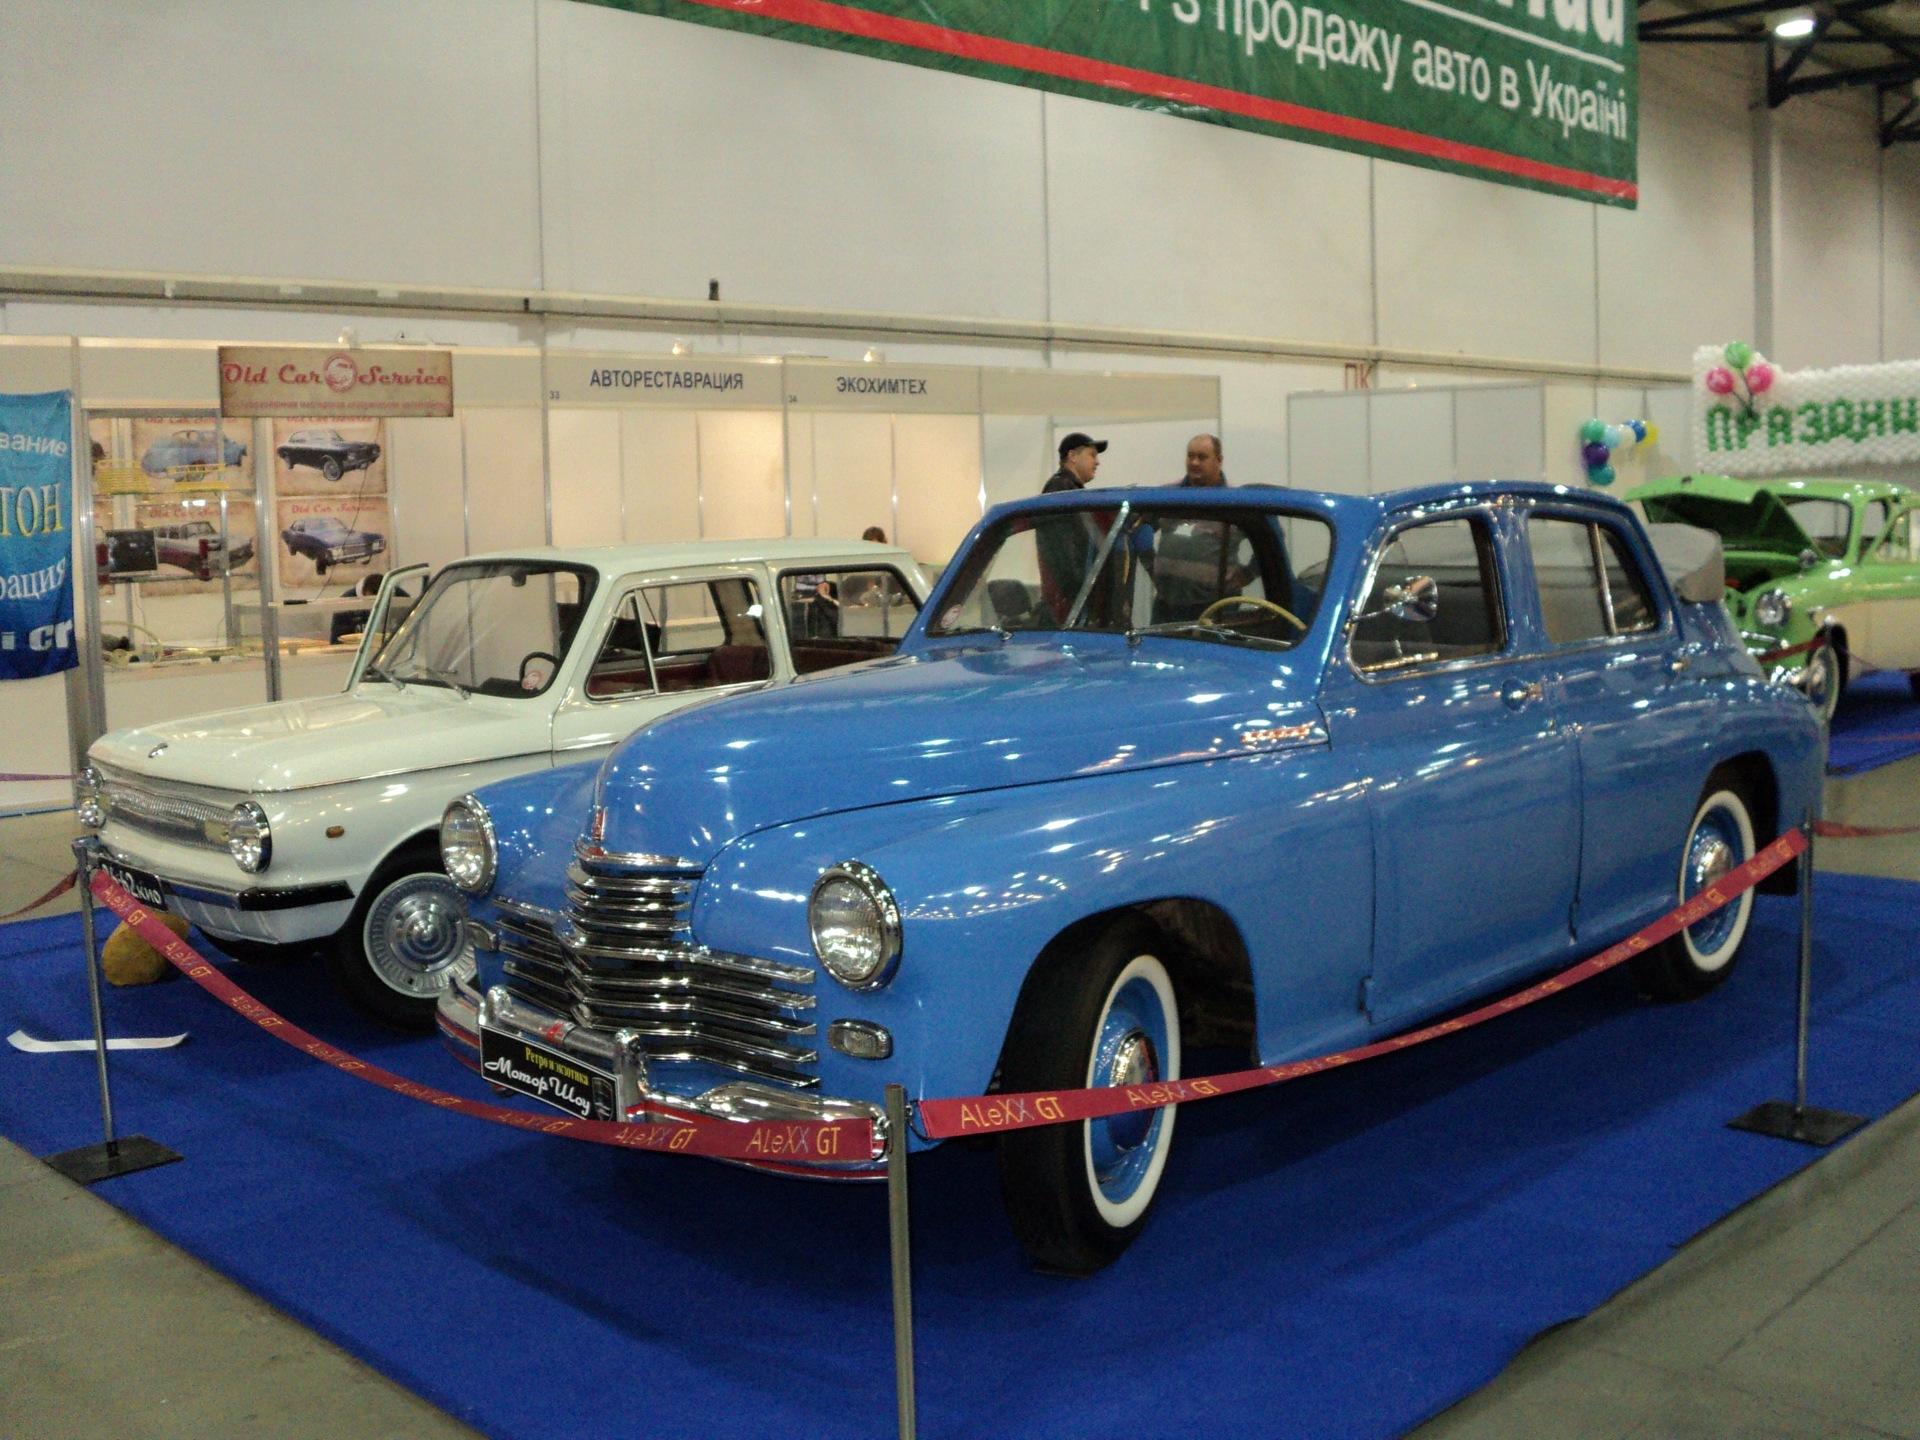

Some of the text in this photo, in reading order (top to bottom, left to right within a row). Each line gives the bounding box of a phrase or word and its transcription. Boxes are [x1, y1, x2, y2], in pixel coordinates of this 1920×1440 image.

[1412, 39, 1491, 102] авто
[1500, 65, 1520, 110] в
[1526, 58, 1627, 140] Україні
[222, 362, 268, 385] Old
[278, 363, 323, 386] Car
[357, 364, 450, 387] Service
[589, 368, 744, 393] АВТОРЕСТАВРАЦИЯ
[836, 376, 928, 395] ЭКОХИМТЕХ
[484, 1056, 549, 1096] Мотор
[548, 1076, 592, 1116] Шоу
[1190, 1079, 1222, 1096] GT
[1035, 1096, 1066, 1121] GT
[668, 1128, 698, 1150] GT
[816, 1126, 842, 1156] GT
